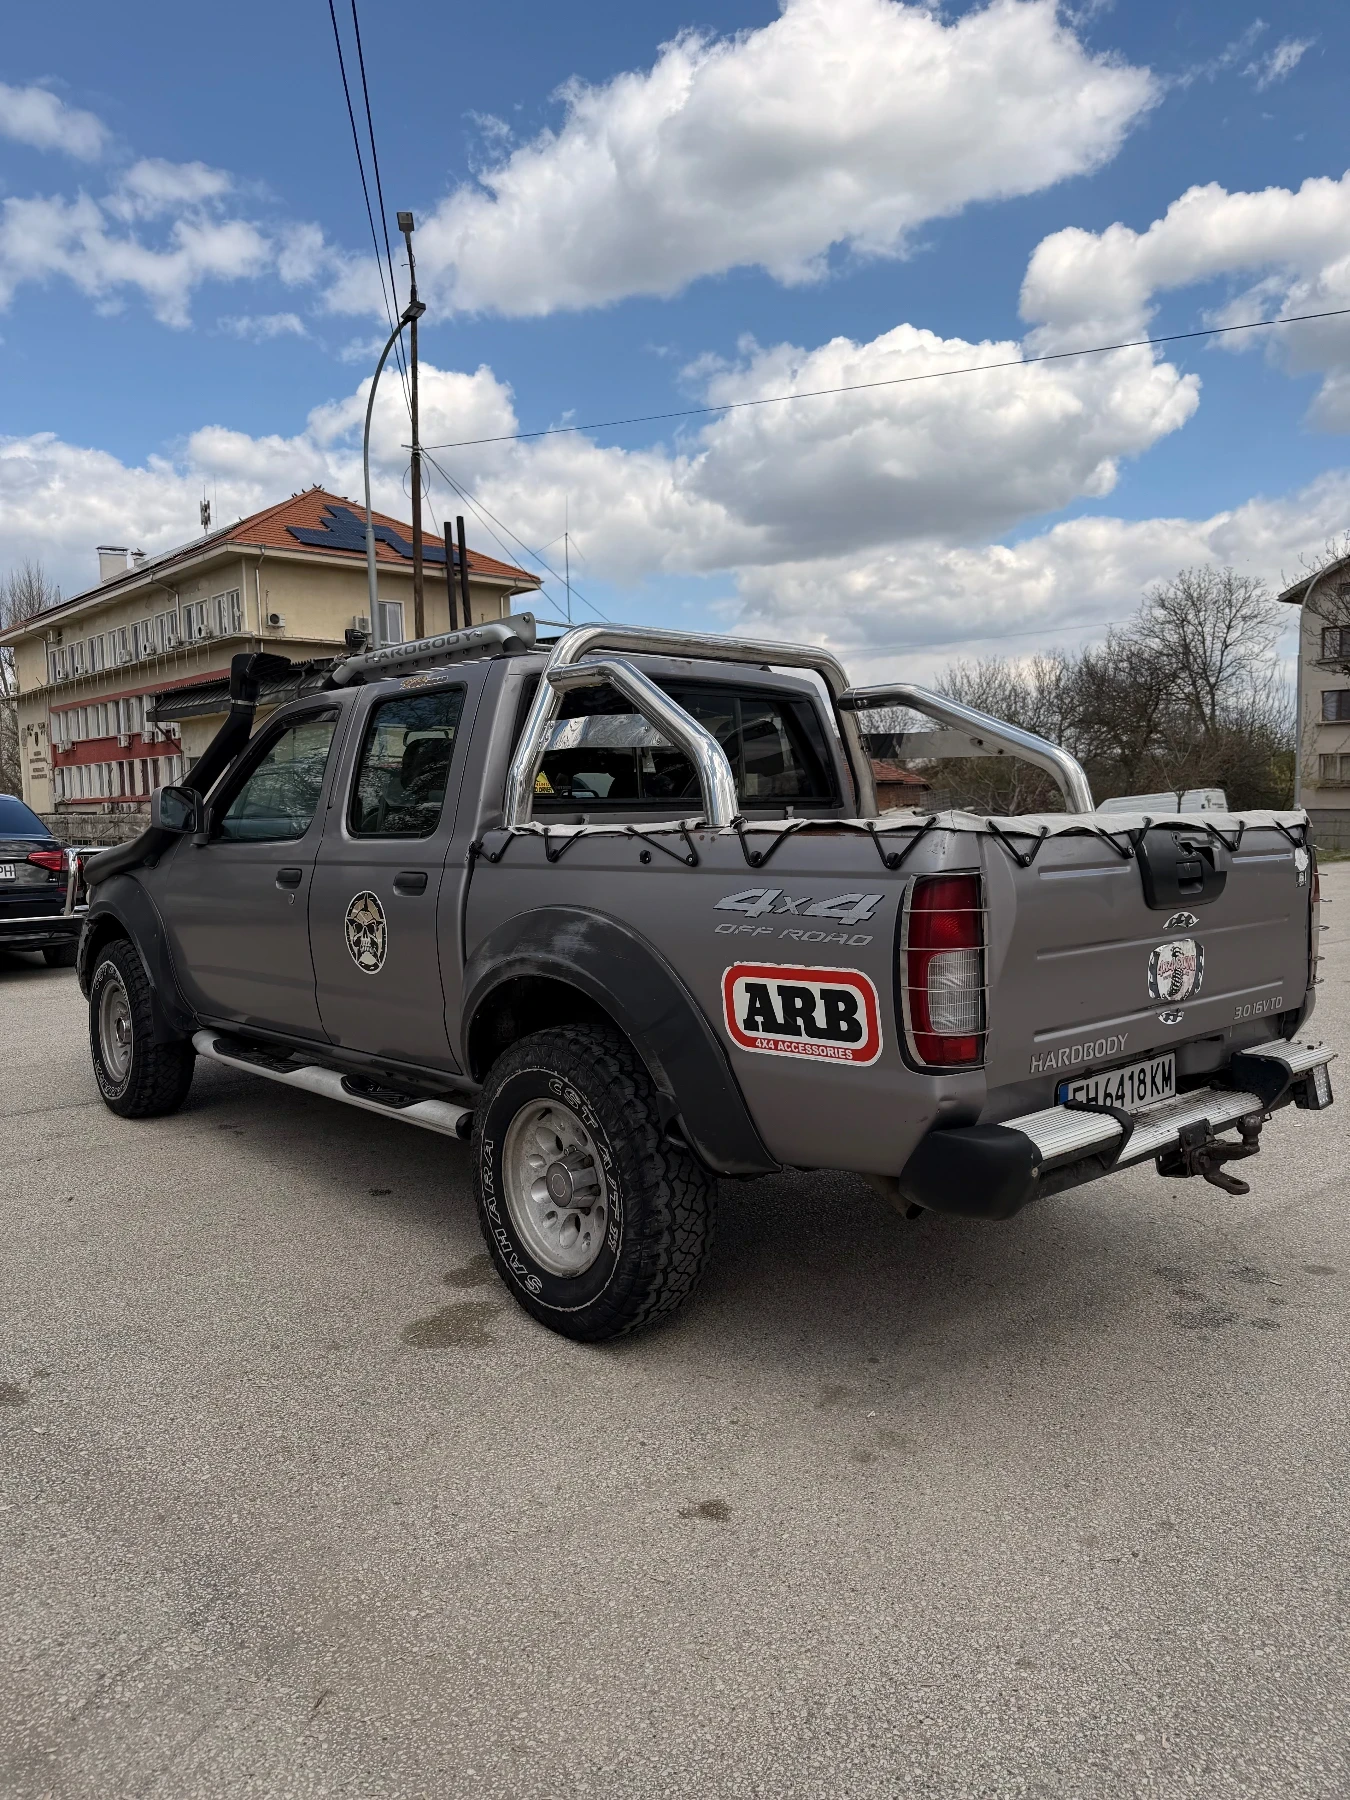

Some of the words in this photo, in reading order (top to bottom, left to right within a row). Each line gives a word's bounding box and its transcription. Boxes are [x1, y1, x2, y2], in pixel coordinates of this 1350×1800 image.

[715, 923, 773, 938] OFF
[778, 928, 874, 946] ROAD
[743, 982, 863, 1043] ARB
[755, 1038, 775, 1050] 4X4
[777, 1041, 853, 1060] ACCESSORIES
[1030, 1033, 1129, 1073] HARDBODY
[549, 1077, 599, 1129] CST
[483, 1139, 543, 1295] SAHARA
